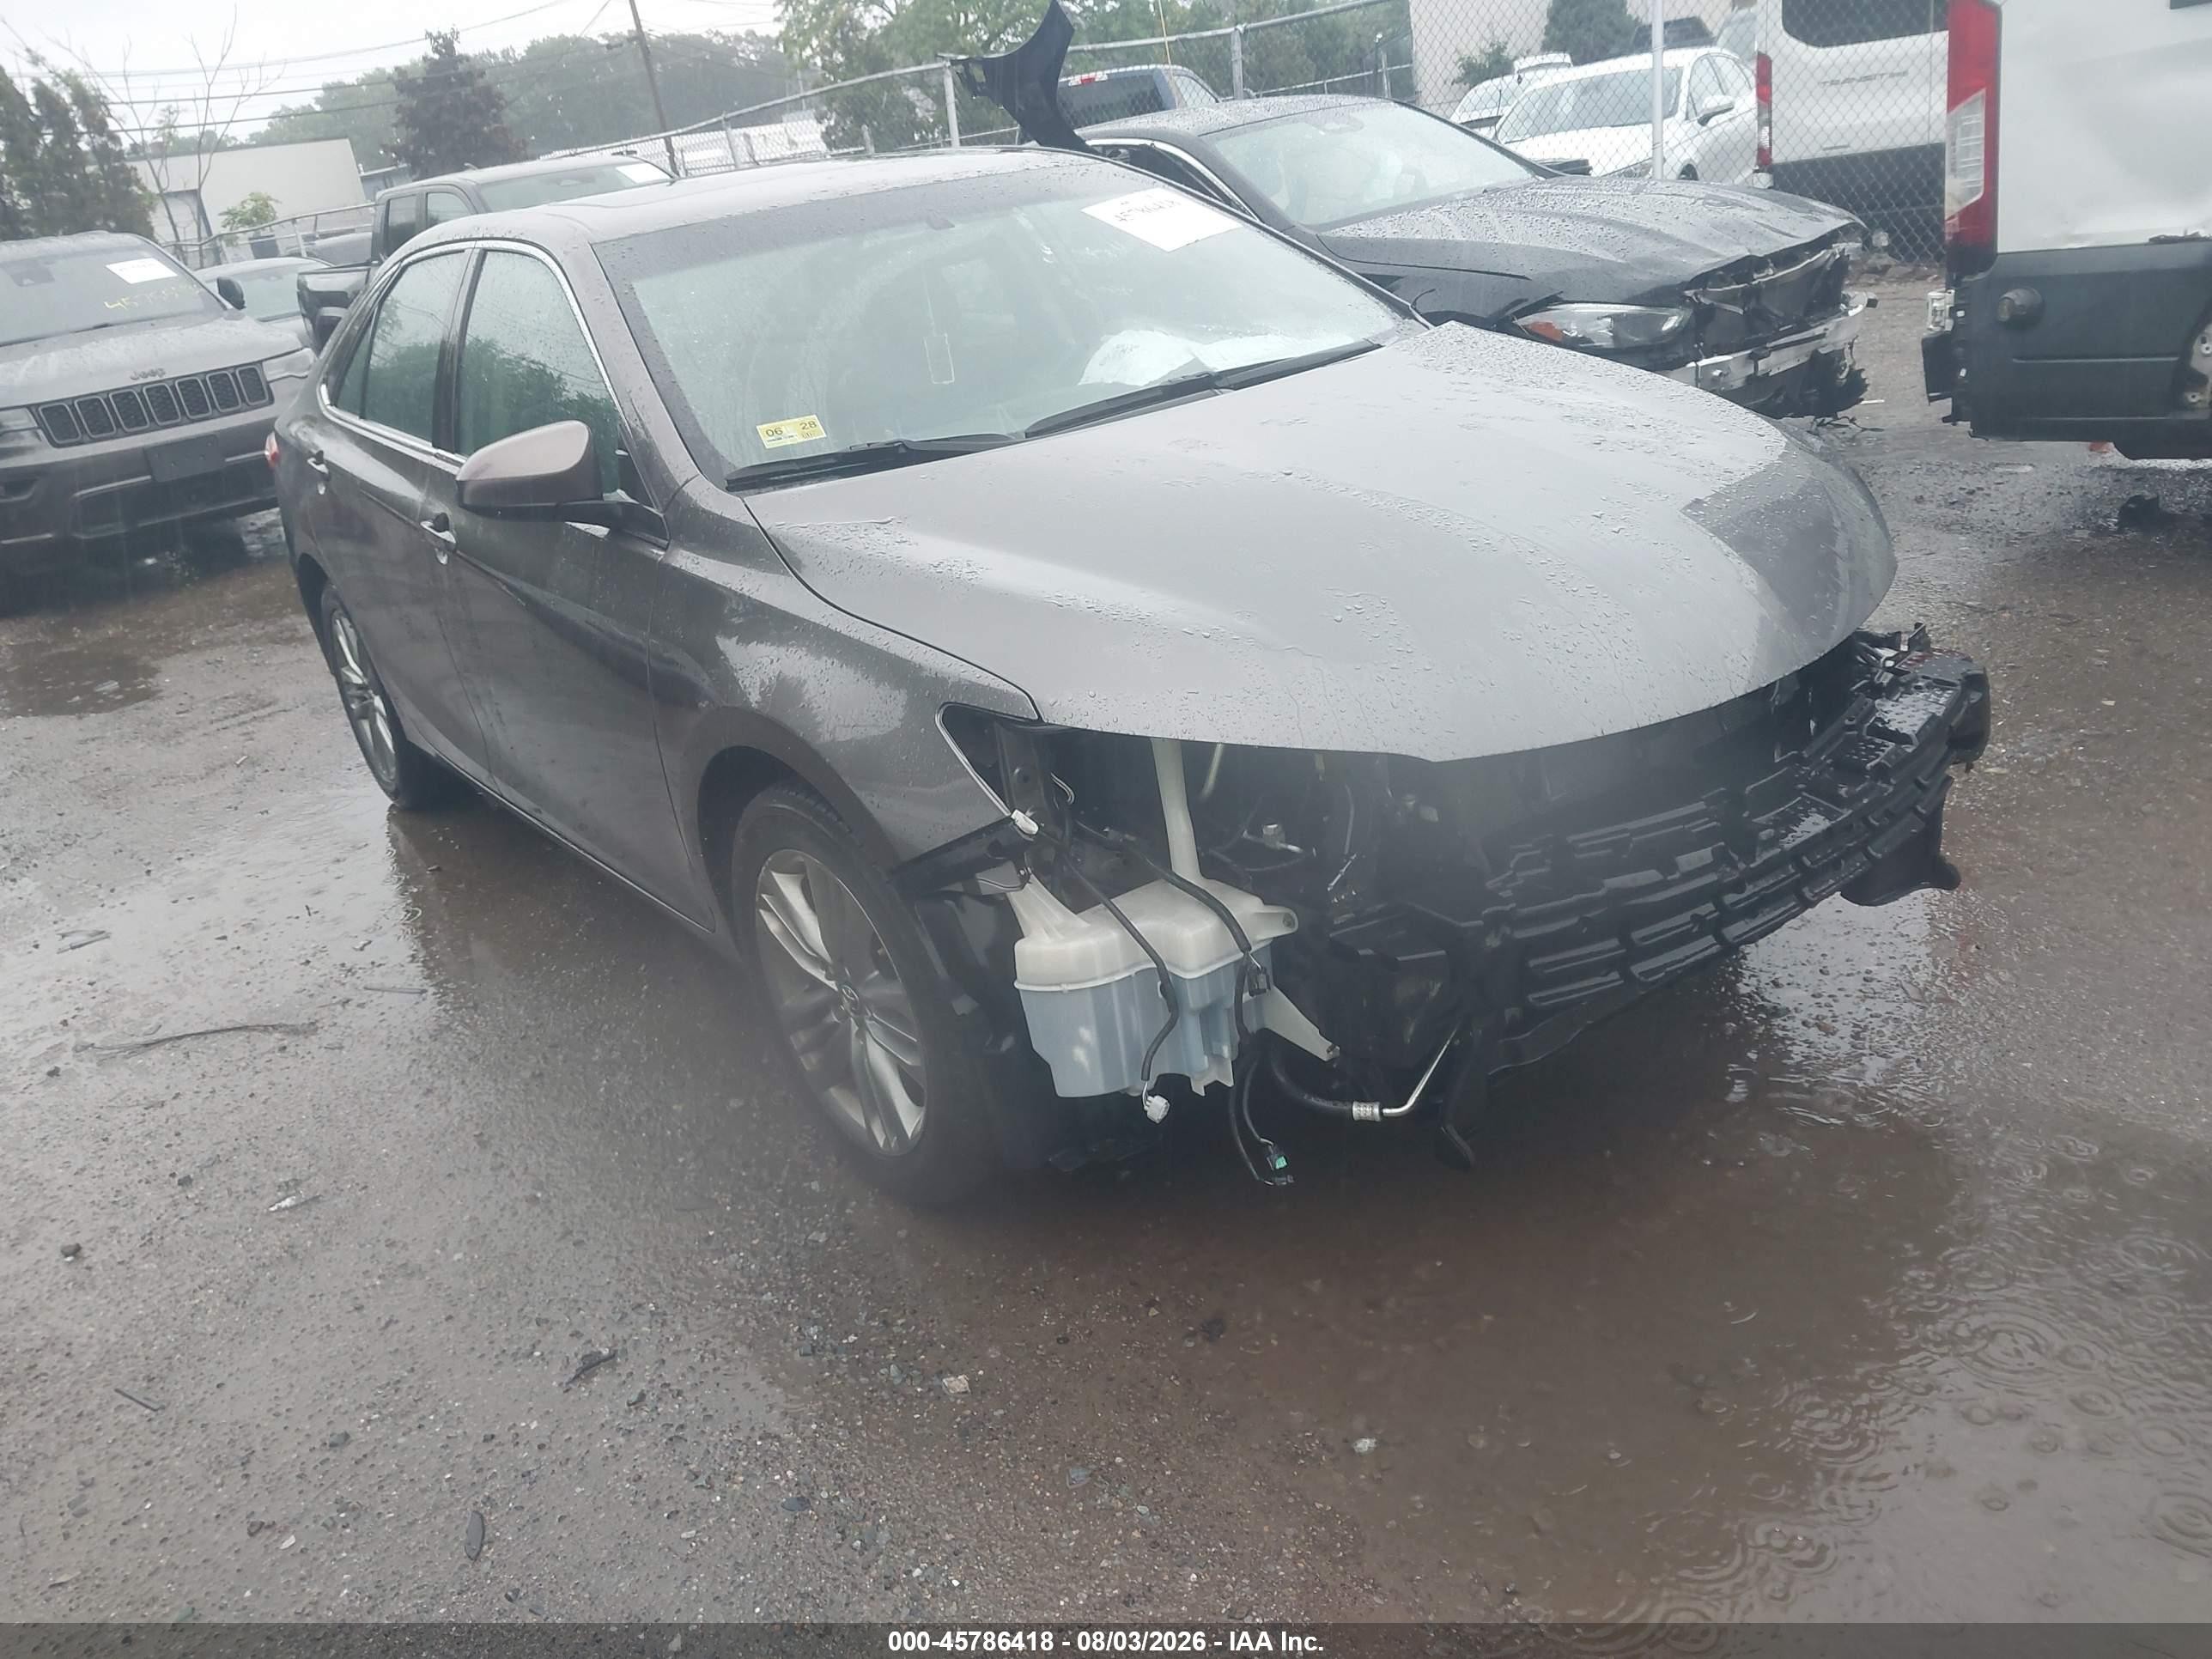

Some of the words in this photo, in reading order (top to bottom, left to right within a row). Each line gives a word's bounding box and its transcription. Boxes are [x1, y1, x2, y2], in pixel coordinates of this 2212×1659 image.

[130, 368, 166, 380] Jeep
[765, 427, 783, 437] 06
[799, 420, 817, 430] 28
